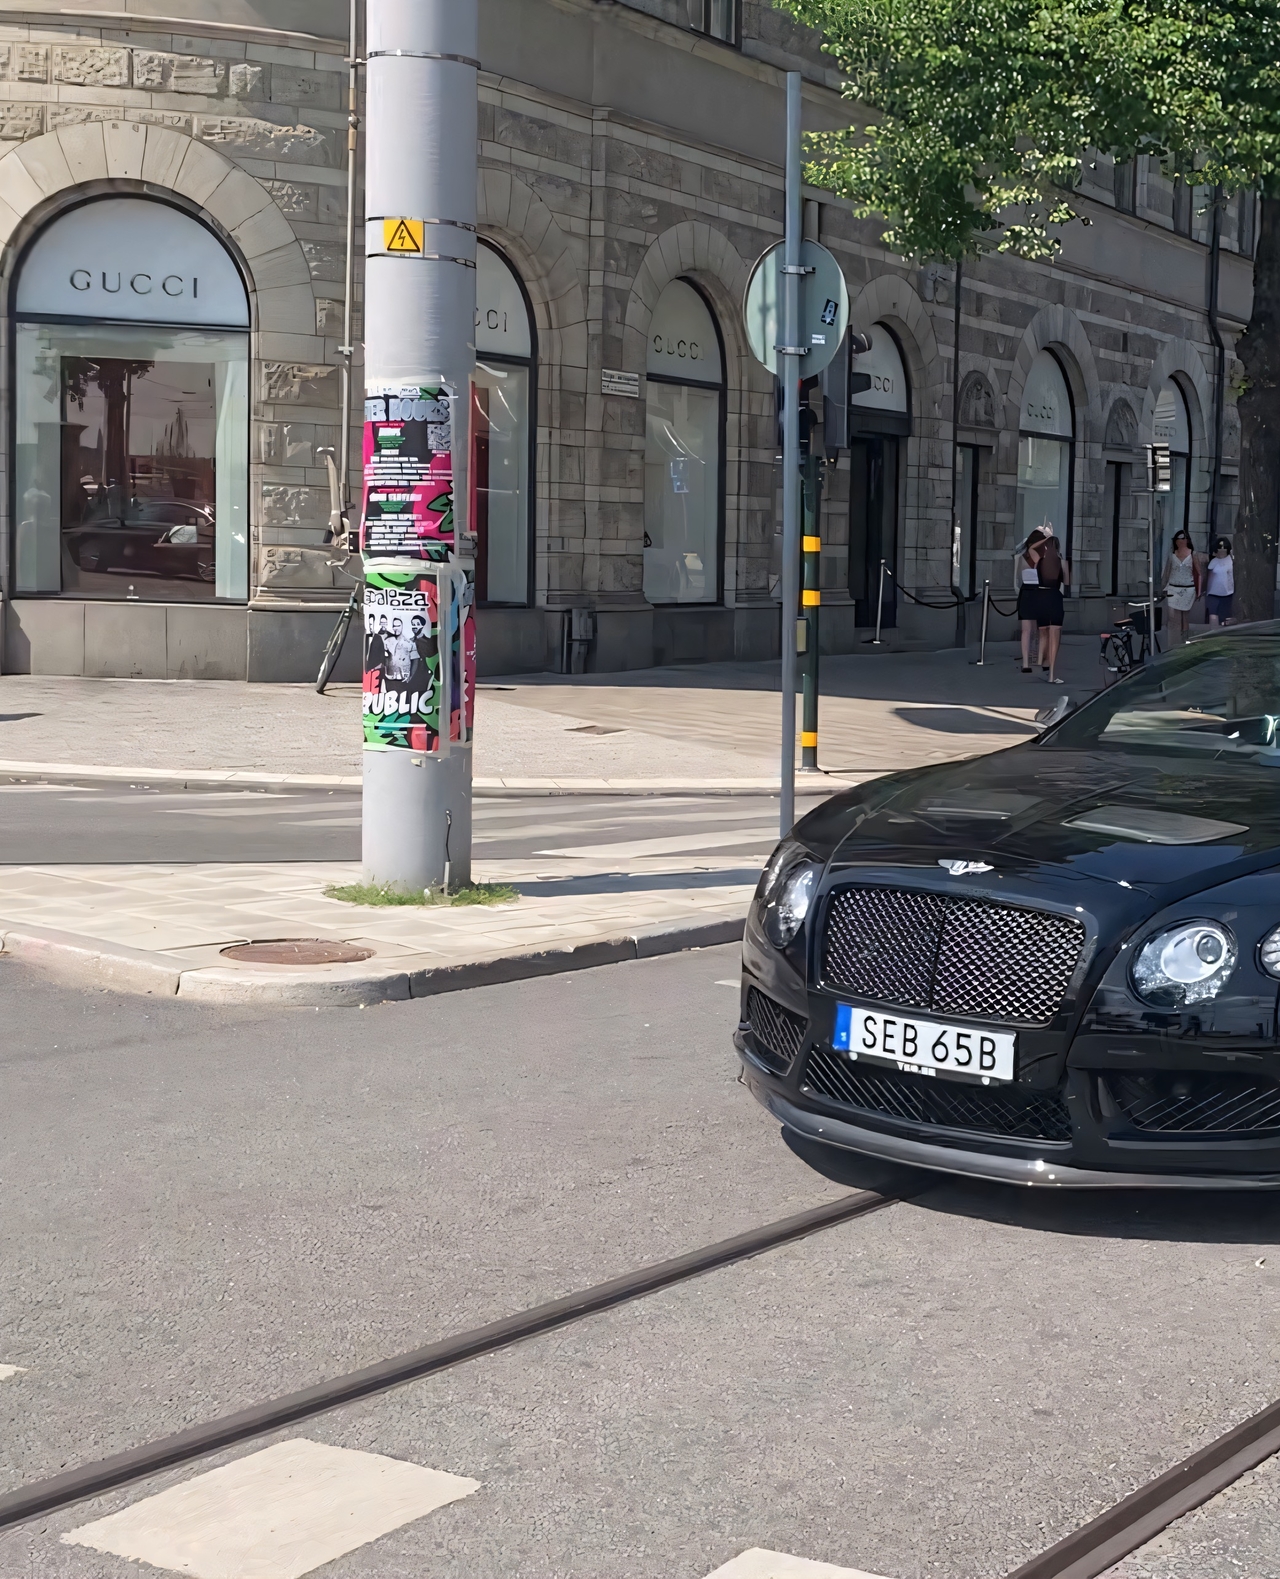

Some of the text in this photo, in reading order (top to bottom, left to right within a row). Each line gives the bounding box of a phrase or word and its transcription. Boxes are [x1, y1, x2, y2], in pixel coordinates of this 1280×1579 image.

[69, 269, 198, 298] GUCCI
[862, 1015, 996, 1071] SEB 65B
